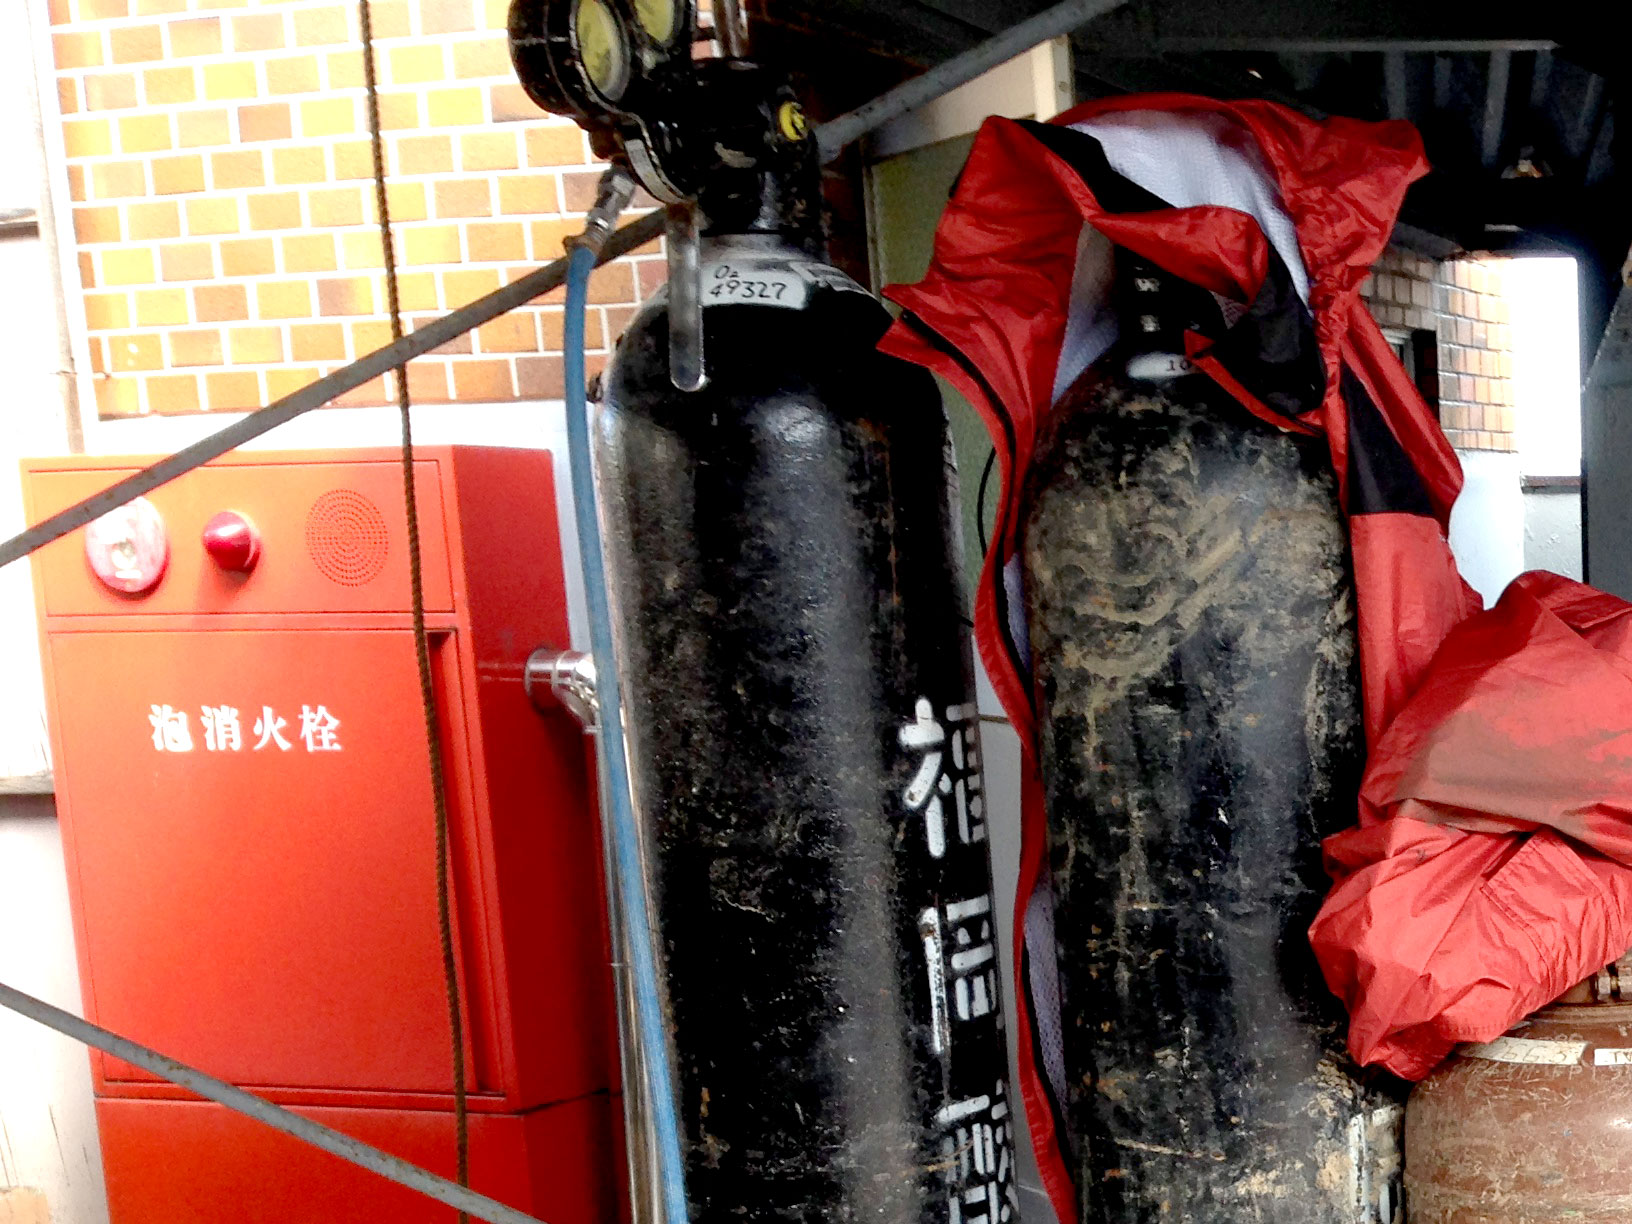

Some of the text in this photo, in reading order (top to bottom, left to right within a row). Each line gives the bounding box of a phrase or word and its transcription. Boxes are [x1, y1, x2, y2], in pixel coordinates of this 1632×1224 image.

[709, 279, 788, 300] 49327
[148, 703, 342, 752] 泡消火栓
